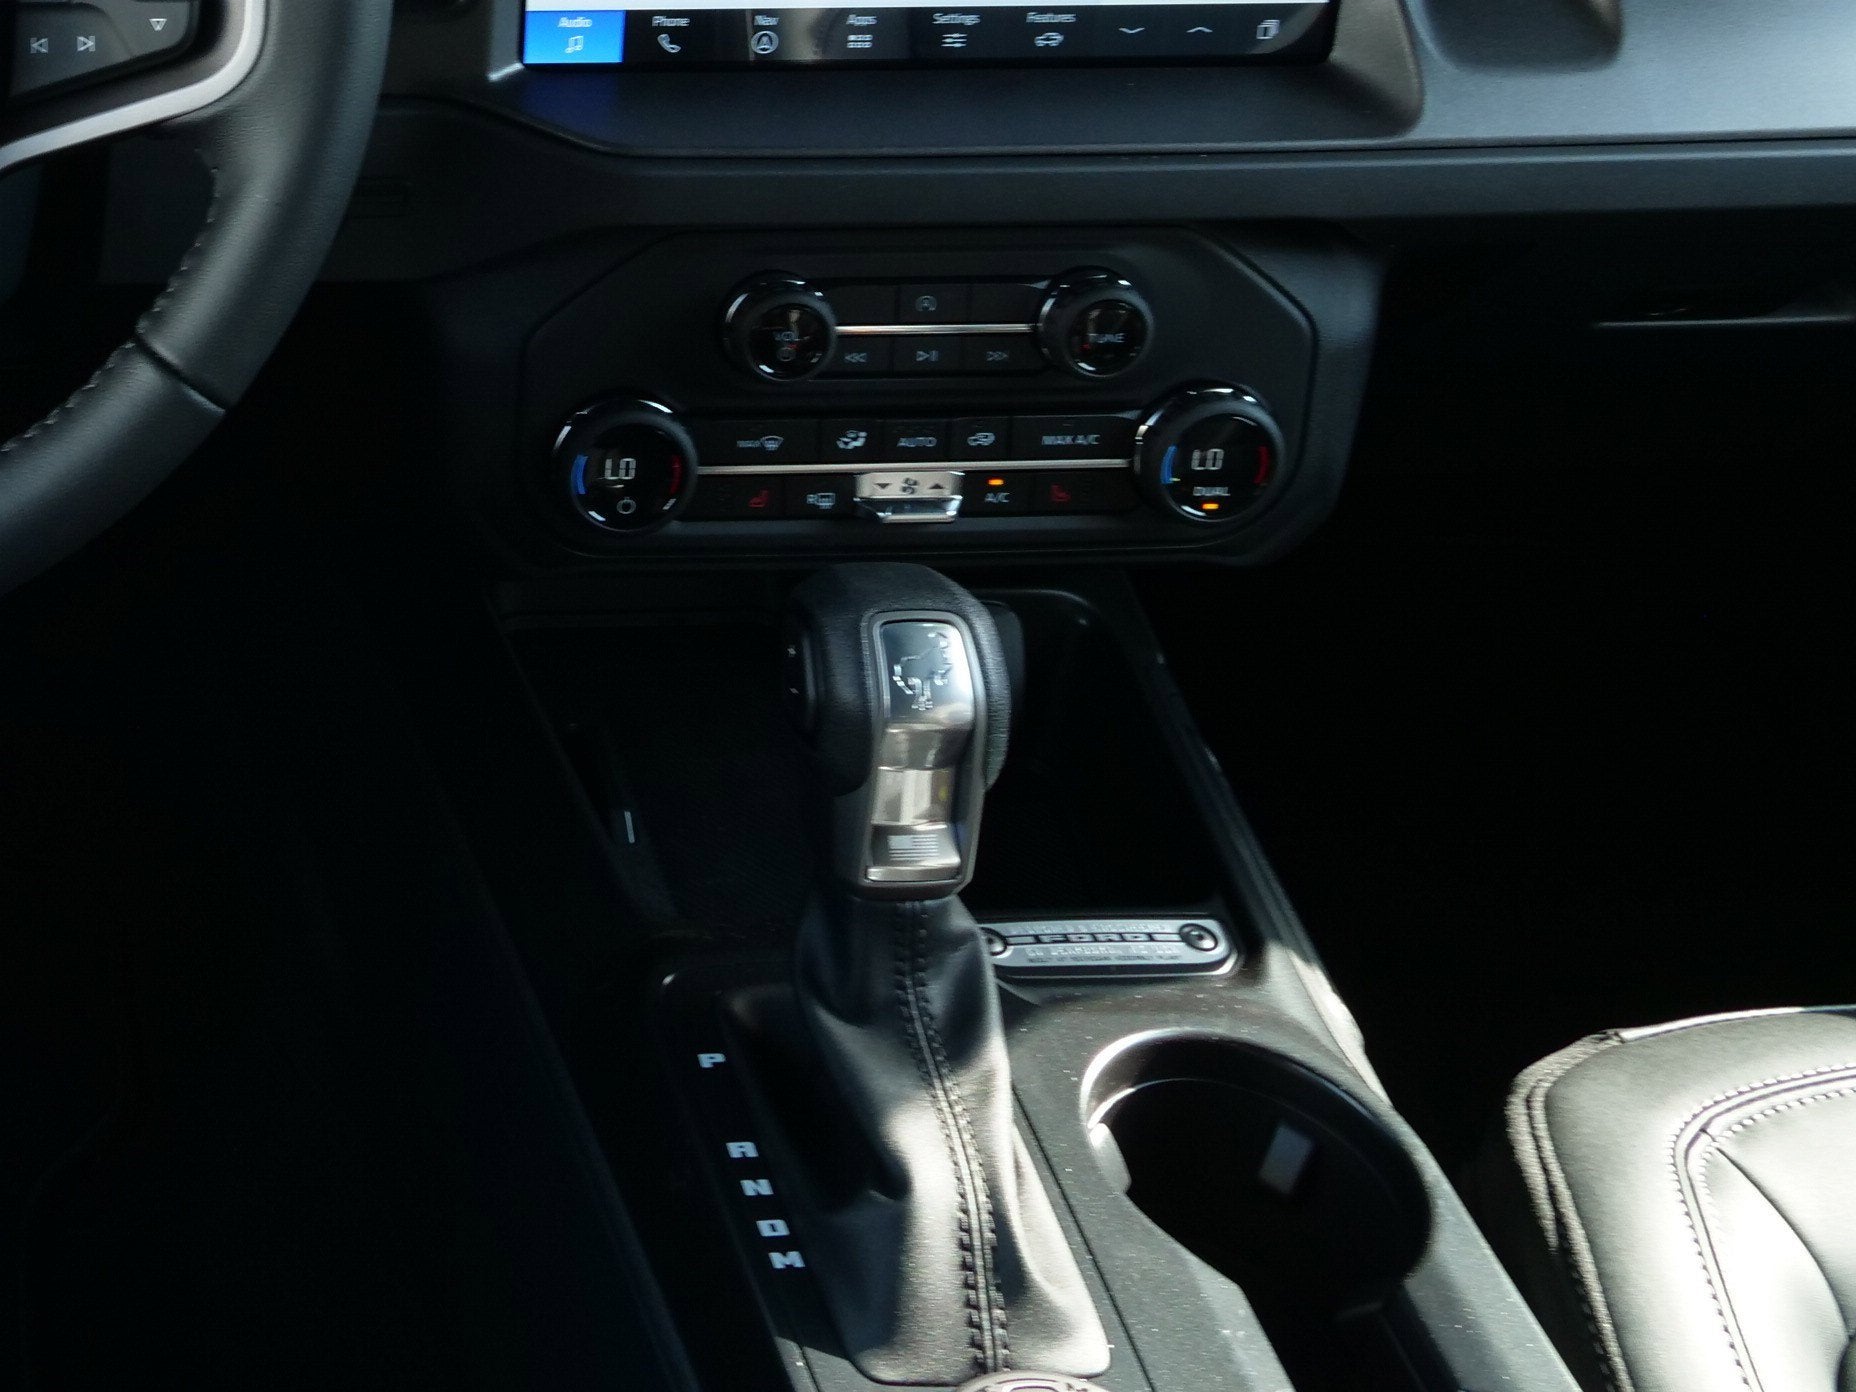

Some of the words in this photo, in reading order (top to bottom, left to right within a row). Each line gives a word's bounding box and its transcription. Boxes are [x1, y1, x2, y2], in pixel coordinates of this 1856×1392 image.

[558, 16, 593, 28] Audio
[652, 15, 690, 27] Phone
[754, 14, 780, 26] Nav
[846, 14, 877, 27] Apps
[932, 12, 981, 26] Settings
[1026, 11, 1077, 24] Features
[896, 436, 937, 448] AUTO
[1191, 448, 1225, 470] LO
[604, 457, 637, 480] LO
[984, 492, 1011, 504] A/C
[1193, 486, 1232, 497] DUAL
[697, 1053, 726, 1068] P
[740, 1179, 774, 1196] N
[756, 1219, 790, 1237] D
[768, 1251, 806, 1269] M
